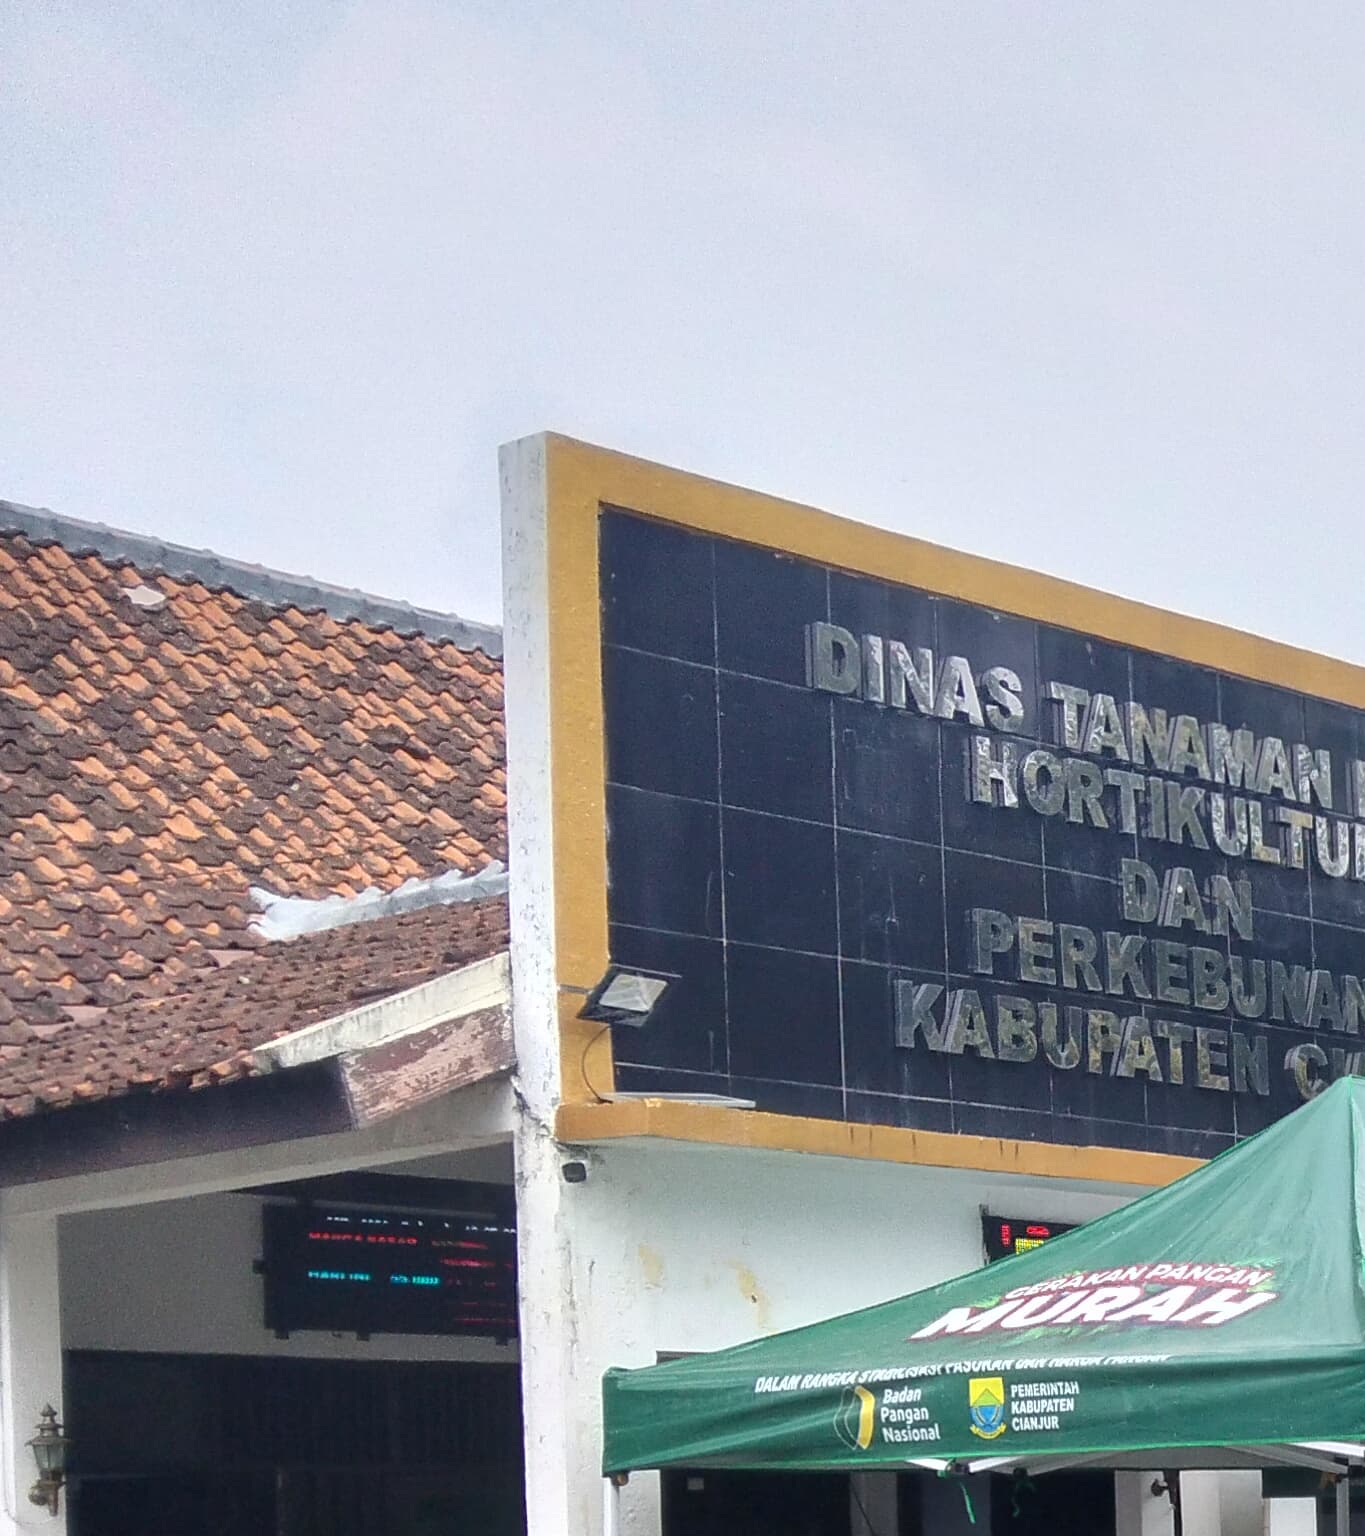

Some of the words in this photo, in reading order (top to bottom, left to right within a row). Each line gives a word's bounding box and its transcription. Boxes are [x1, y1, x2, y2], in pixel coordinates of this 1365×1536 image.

[807, 622, 1023, 733] DINAS
[1045, 683, 1331, 809] TANAMAN
[1120, 857, 1253, 941] DAN
[894, 978, 1270, 1096] KABUPATEN
[1005, 1265, 1148, 1300] GERAKAN
[1146, 1263, 1272, 1286] PANGAN
[909, 1286, 1279, 1339] MURAH
[755, 1375, 802, 1394] DALAM
[800, 1371, 859, 1388] RANGKA
[1011, 1381, 1079, 1397] PEMERINTAH
[884, 1387, 921, 1403] Badan
[1011, 1398, 1074, 1413] KABUPATEN
[881, 1406, 929, 1425] Pangan
[1012, 1415, 1060, 1431] CIANJUR
[882, 1425, 940, 1443] Nasional
